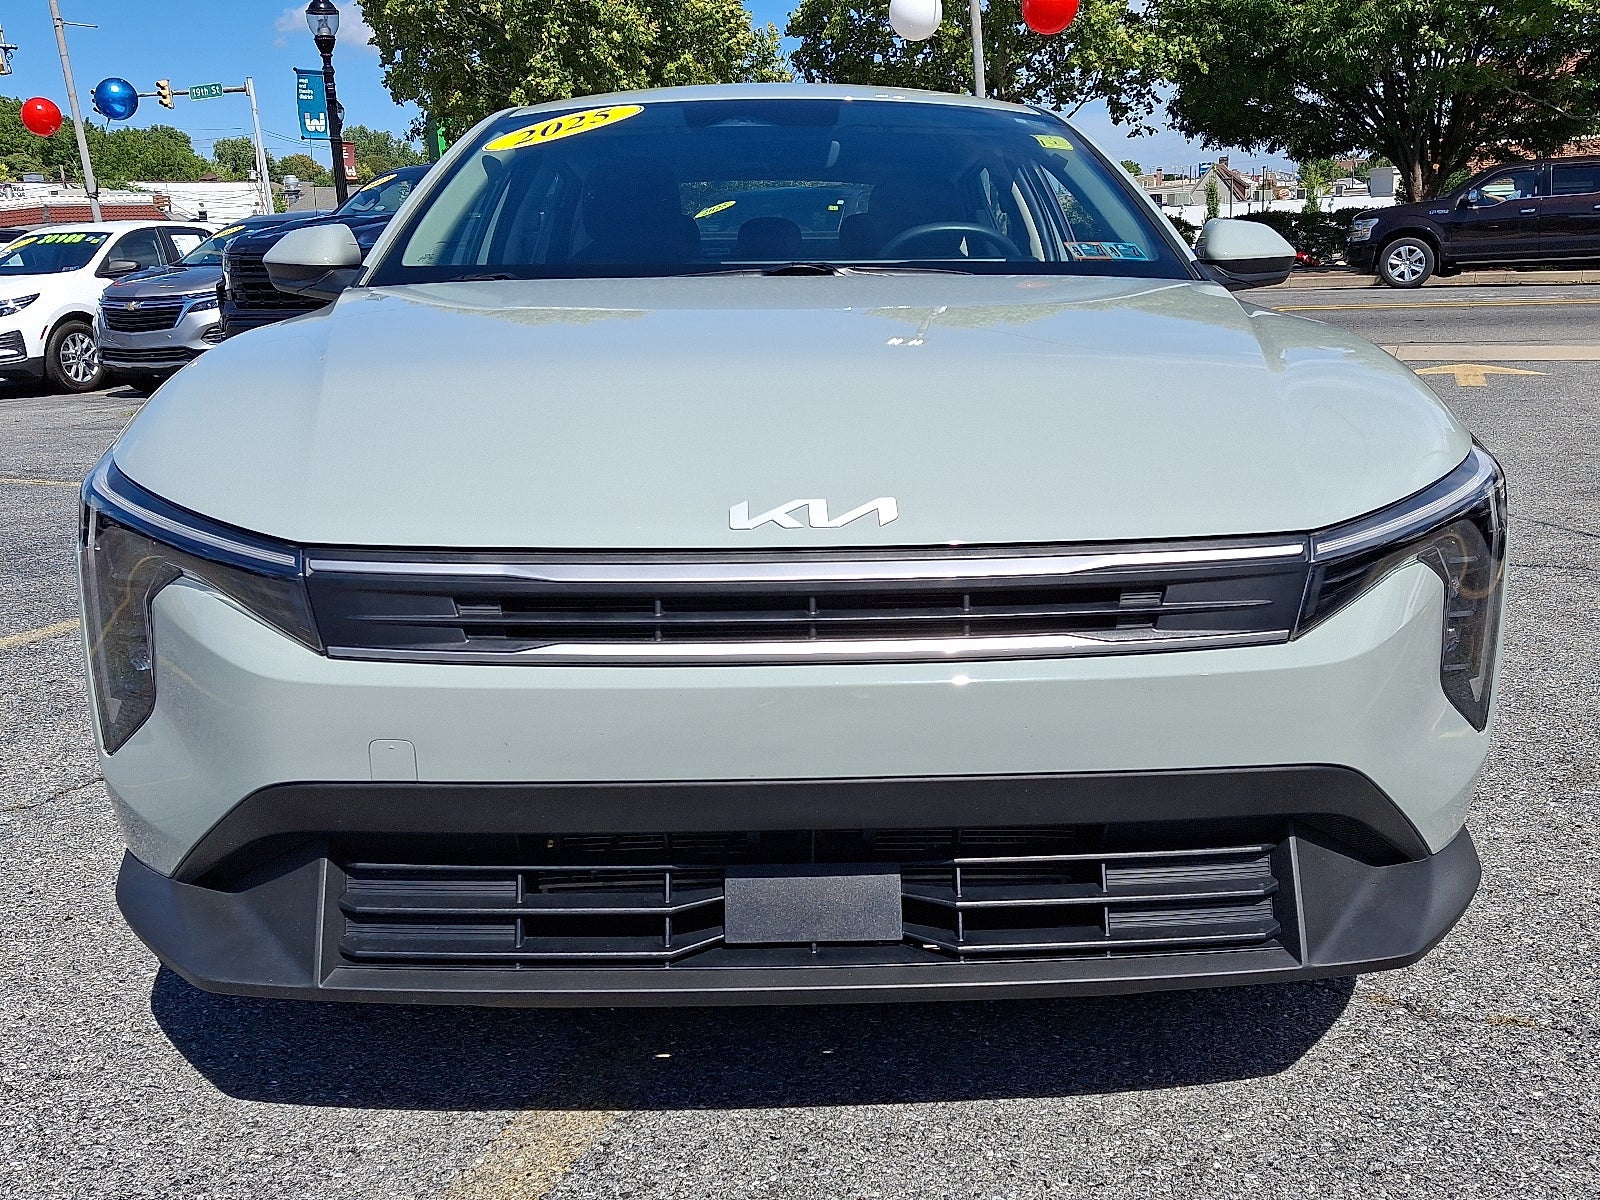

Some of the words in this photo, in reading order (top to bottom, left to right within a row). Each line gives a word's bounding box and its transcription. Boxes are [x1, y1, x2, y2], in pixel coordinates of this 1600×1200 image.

[192, 87, 208, 97] 19th
[211, 85, 221, 95] St
[514, 108, 612, 146] 2025
[729, 496, 899, 530] KIA
